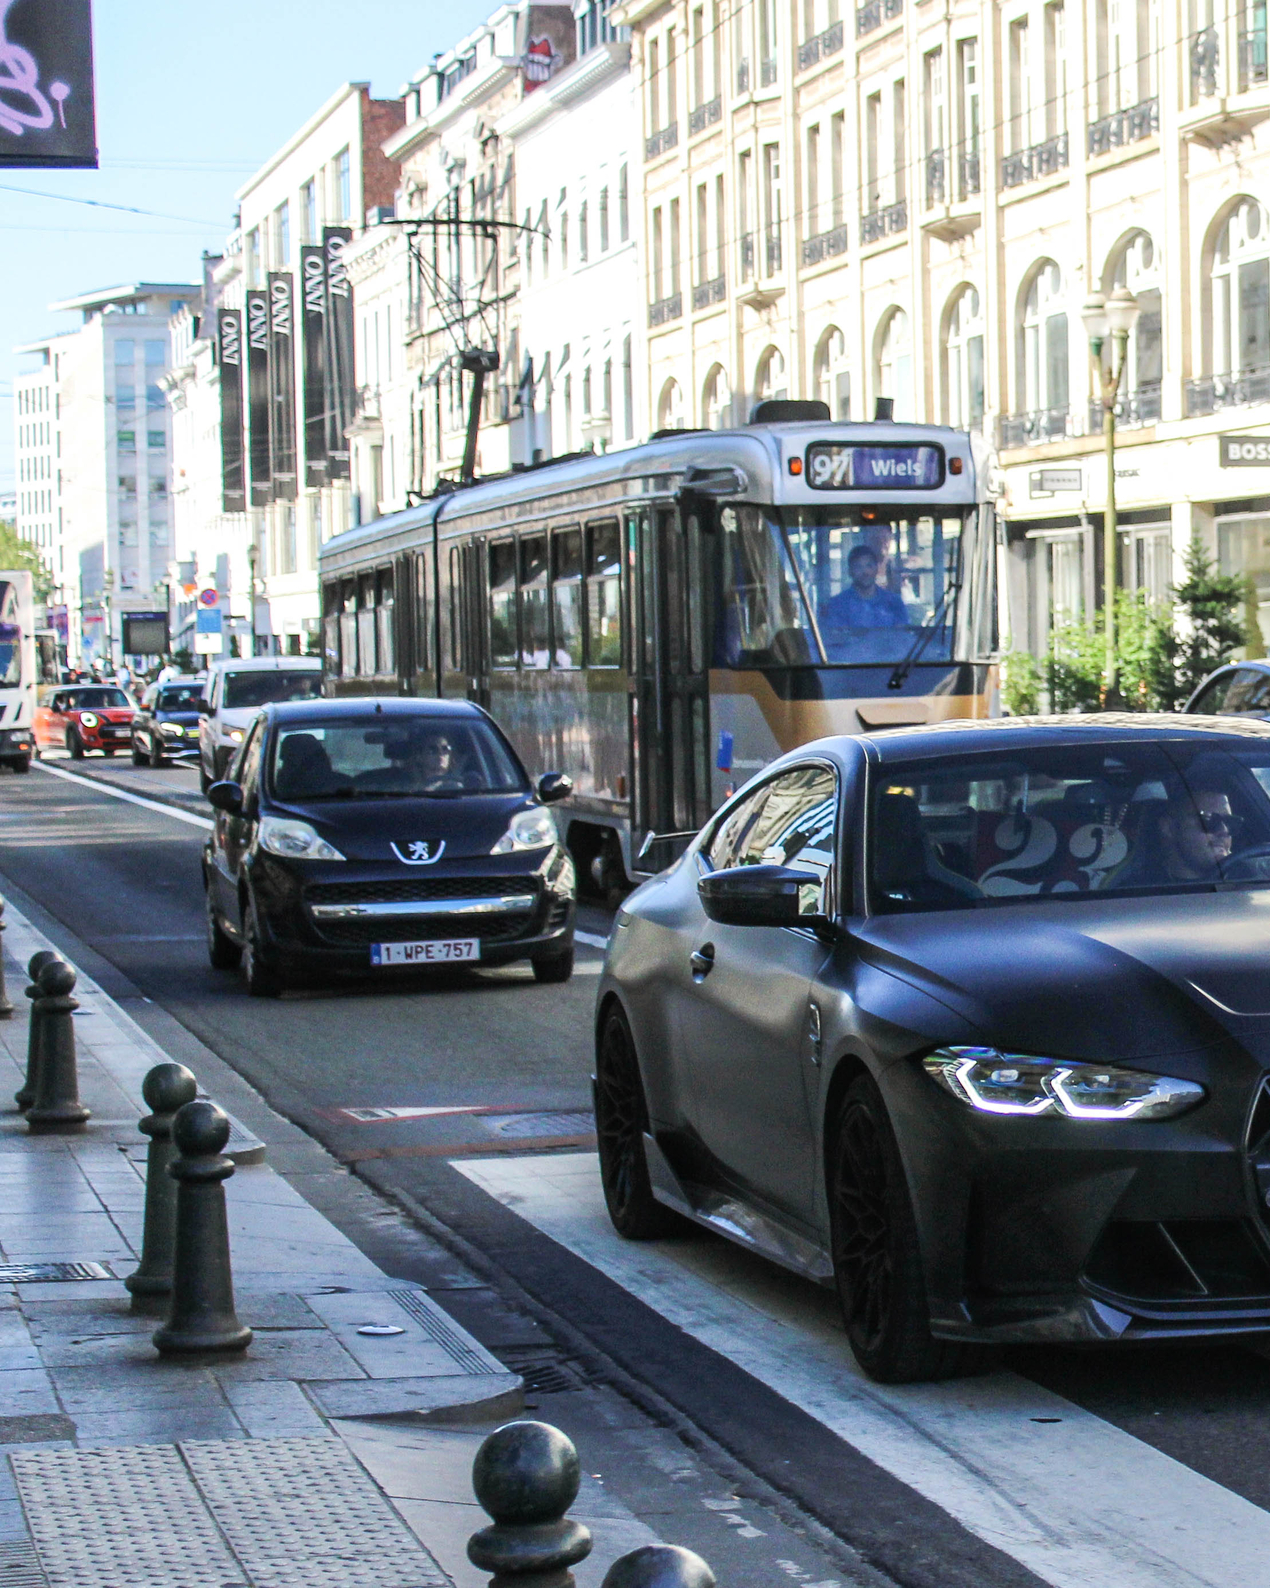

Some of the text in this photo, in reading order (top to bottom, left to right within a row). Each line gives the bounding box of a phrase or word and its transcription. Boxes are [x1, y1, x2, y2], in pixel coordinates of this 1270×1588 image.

[271, 280, 290, 336] INNO
[305, 255, 325, 314] INNO
[221, 316, 239, 366] INNO
[249, 298, 267, 351] INNO
[813, 454, 922, 487] 97 Wiels
